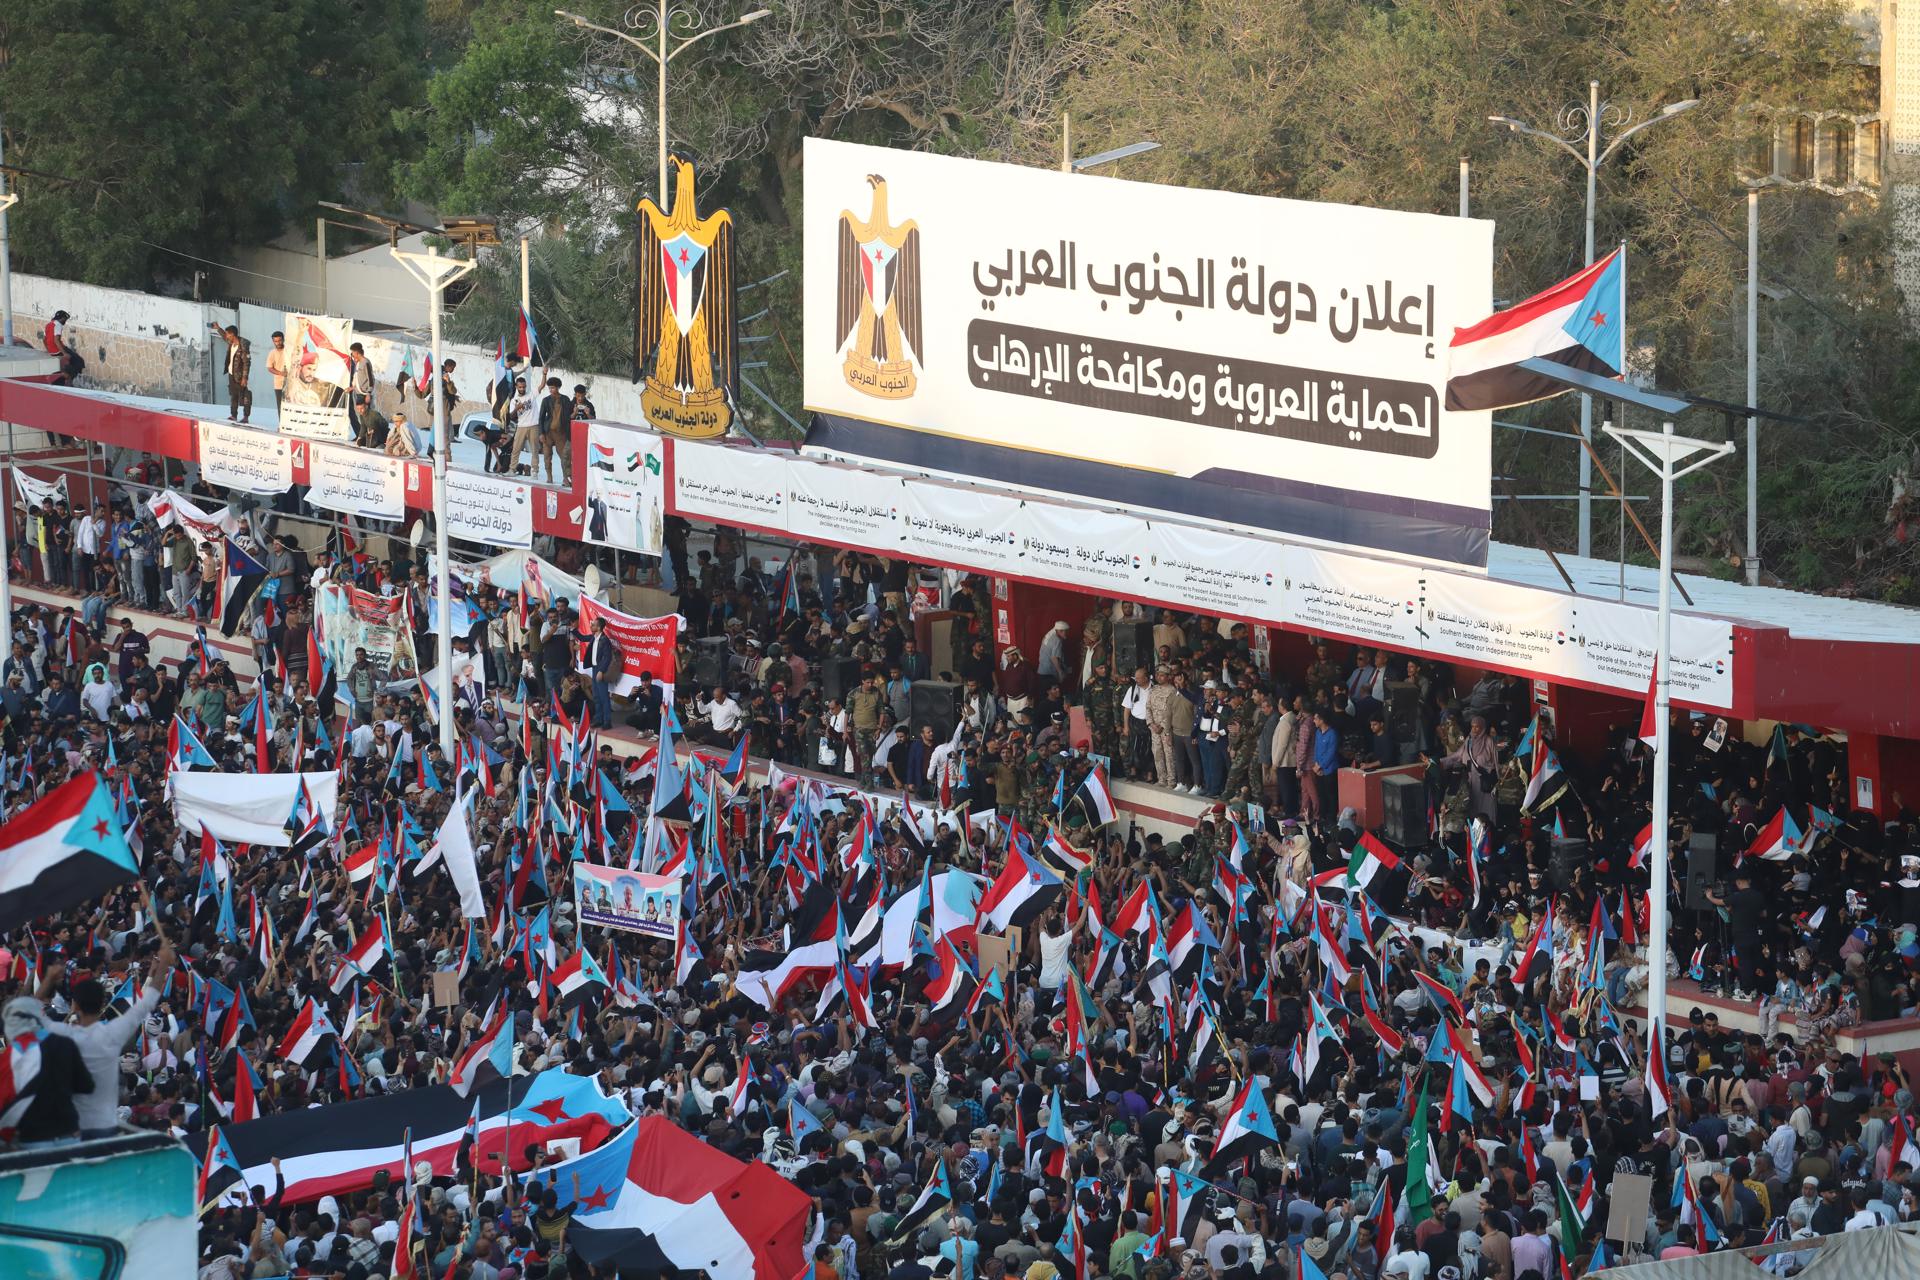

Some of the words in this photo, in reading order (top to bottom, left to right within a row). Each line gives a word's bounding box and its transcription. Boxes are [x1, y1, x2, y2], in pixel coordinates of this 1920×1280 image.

[972, 239, 1076, 312] العربي
[1086, 251, 1215, 322] الجنوب
[1225, 255, 1317, 335] دولة
[1328, 279, 1435, 360] إعلان
[972, 333, 1070, 395] الإرهاب
[849, 368, 877, 387] العربي
[880, 375, 909, 393] الجنوب
[1076, 342, 1206, 416] ومكافحة
[1213, 363, 1319, 426] العروبة
[651, 405, 674, 421] العربي
[1326, 379, 1432, 442] لحماية
[674, 409, 700, 431] الجنوب
[700, 410, 718, 429] دولة
[210, 459, 226, 474] العربي
[228, 462, 248, 477] الجنوب
[249, 464, 262, 480] دولة
[473, 483, 499, 496] التضحيات
[686, 479, 701, 488] مستقل
[709, 484, 720, 496] العربي
[322, 483, 341, 499] العربي
[341, 487, 362, 501] الجنوب
[721, 487, 737, 498] الجنوب
[808, 494, 819, 507] رجعة
[825, 500, 838, 510] شعب
[839, 500, 848, 512] قرار
[850, 505, 866, 516] الجنوب
[869, 505, 888, 517] استقلال
[465, 514, 491, 530] الجنوب
[493, 515, 513, 534] دولة
[912, 516, 928, 529] تموت
[935, 519, 951, 535] وهوية
[953, 522, 965, 537] دولة
[967, 528, 983, 543] العربي
[985, 532, 1005, 544] الجنوب
[1031, 536, 1044, 552] دولة
[1046, 543, 1069, 557] وسيعود
[1076, 546, 1090, 561] دولة
[1092, 550, 1104, 562] كان
[1105, 554, 1129, 568] الجنوب
[1205, 566, 1221, 575] عيدروس
[1198, 574, 1212, 584] الشعب
[1299, 581, 1320, 592] يطالبون
[1305, 594, 1322, 605] العربي
[1324, 597, 1342, 608] الجنوب
[1350, 591, 1373, 601] الاعتصام
[1374, 594, 1389, 605] ساحة
[1344, 598, 1355, 611] دولة
[1390, 600, 1400, 608] من
[1374, 608, 1393, 619] الرئيس
[1437, 609, 1457, 623] المستقلة
[1458, 614, 1472, 628] دولتنا
[1473, 618, 1489, 631] لإعلان
[1490, 619, 1504, 632] الأوان
[1440, 626, 1461, 638] Southern
[1505, 638, 1517, 647] time
[1527, 644, 1543, 652] come
[1519, 627, 1538, 639] الجنوب
[1540, 629, 1553, 642] قيادة
[1456, 641, 1474, 651] declare
[1486, 646, 1519, 658] independent
[1520, 653, 1533, 661] state
[1604, 642, 1611, 651] حق
[1612, 641, 1633, 653] استقلالنا
[1587, 651, 1595, 660] The
[1596, 655, 1613, 665] people
[1628, 660, 1642, 670] South
[1681, 656, 1698, 667] الجنوب
[1699, 660, 1713, 669] شعب
[1606, 665, 1641, 679] independence
[1688, 683, 1699, 691] right
